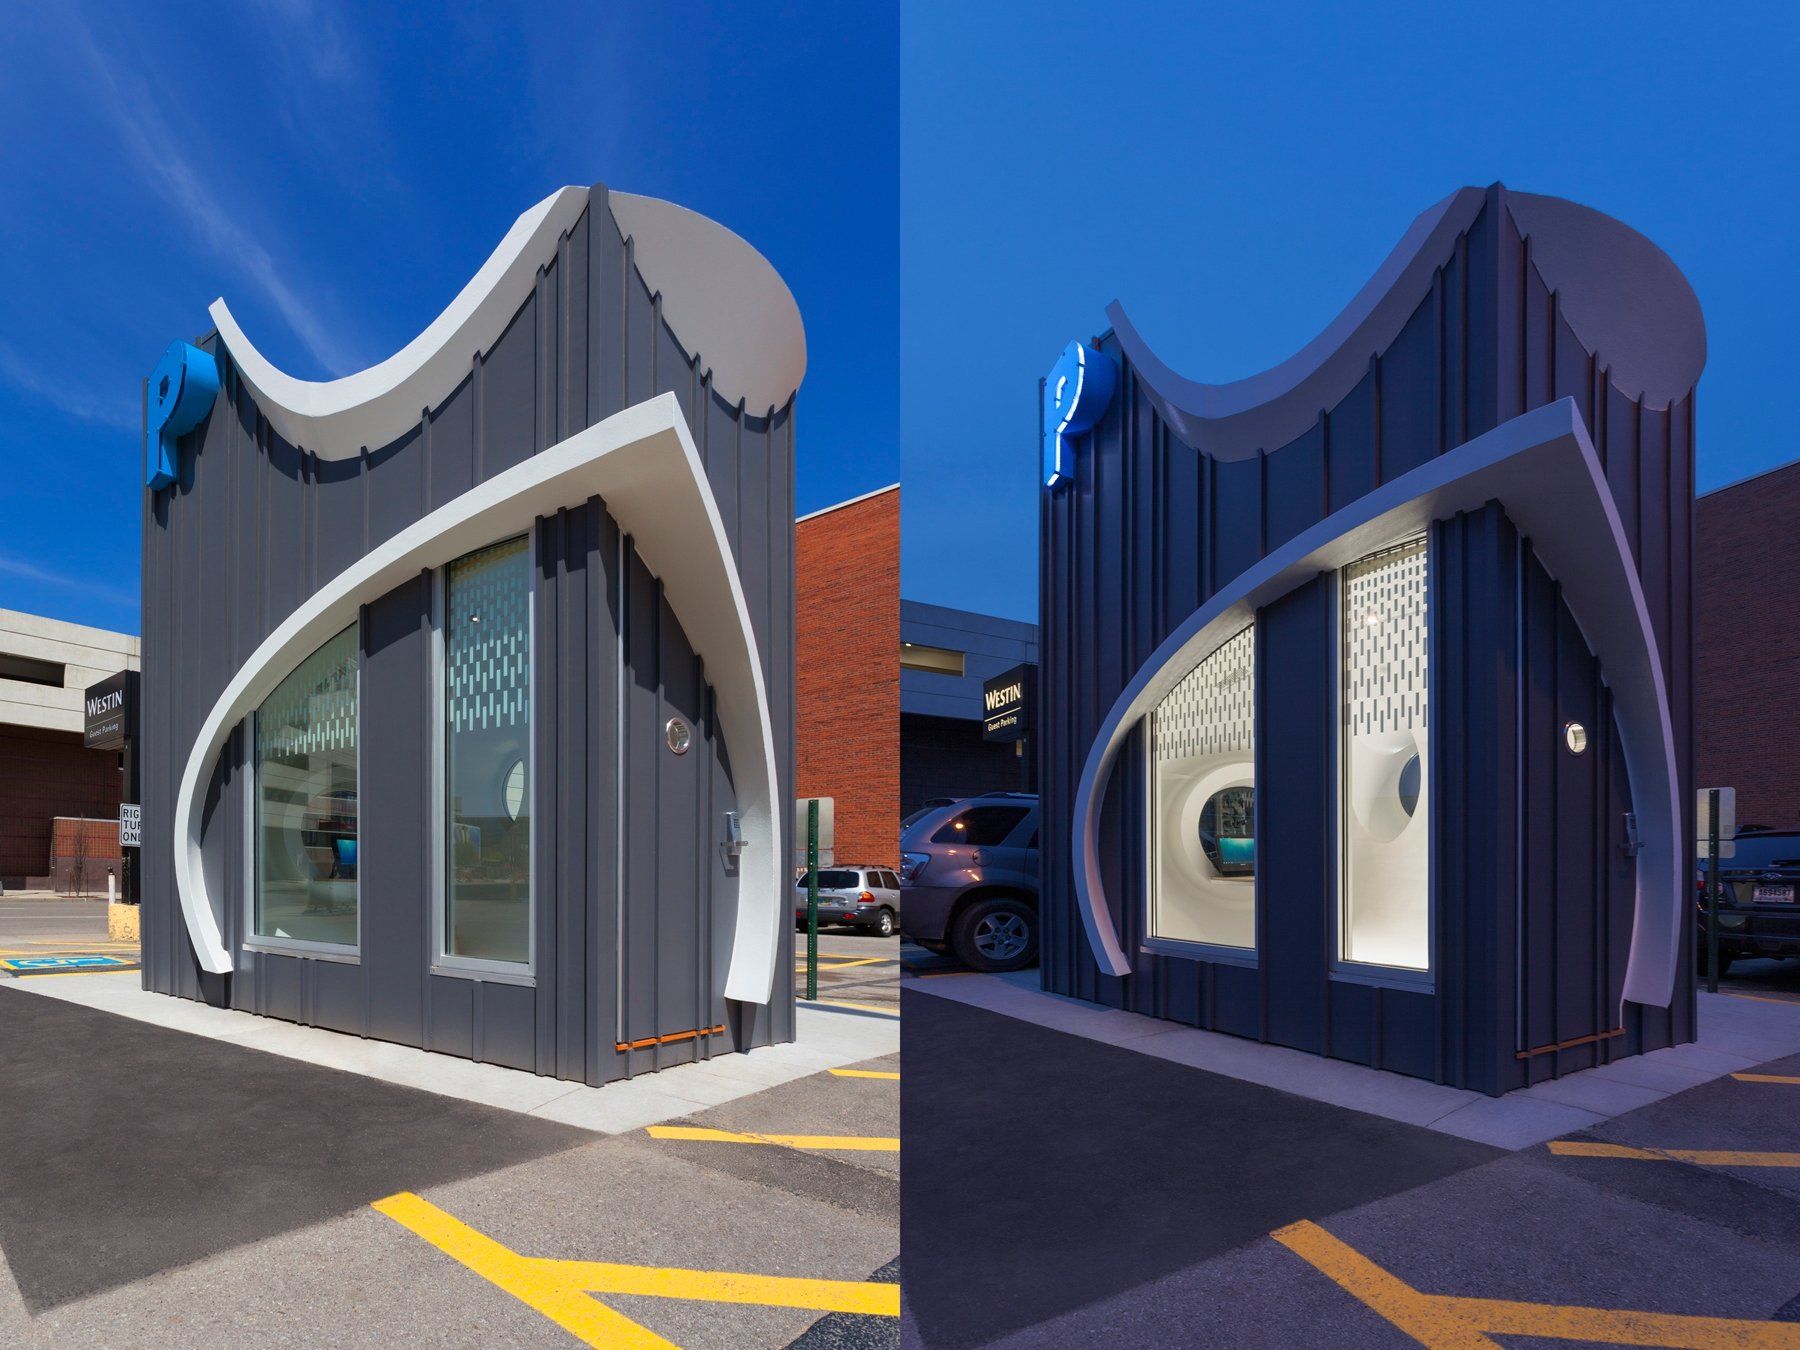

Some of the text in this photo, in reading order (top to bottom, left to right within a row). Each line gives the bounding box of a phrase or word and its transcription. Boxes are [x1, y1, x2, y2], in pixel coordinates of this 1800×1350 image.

[87, 689, 122, 717] WESTIN
[985, 683, 1021, 710] WESTIN
[89, 723, 119, 738] Guest Parking
[988, 716, 1017, 731] Guest Parking
[123, 809, 139, 819] RIG
[123, 820, 140, 830] TUR
[123, 832, 140, 842] ONL
